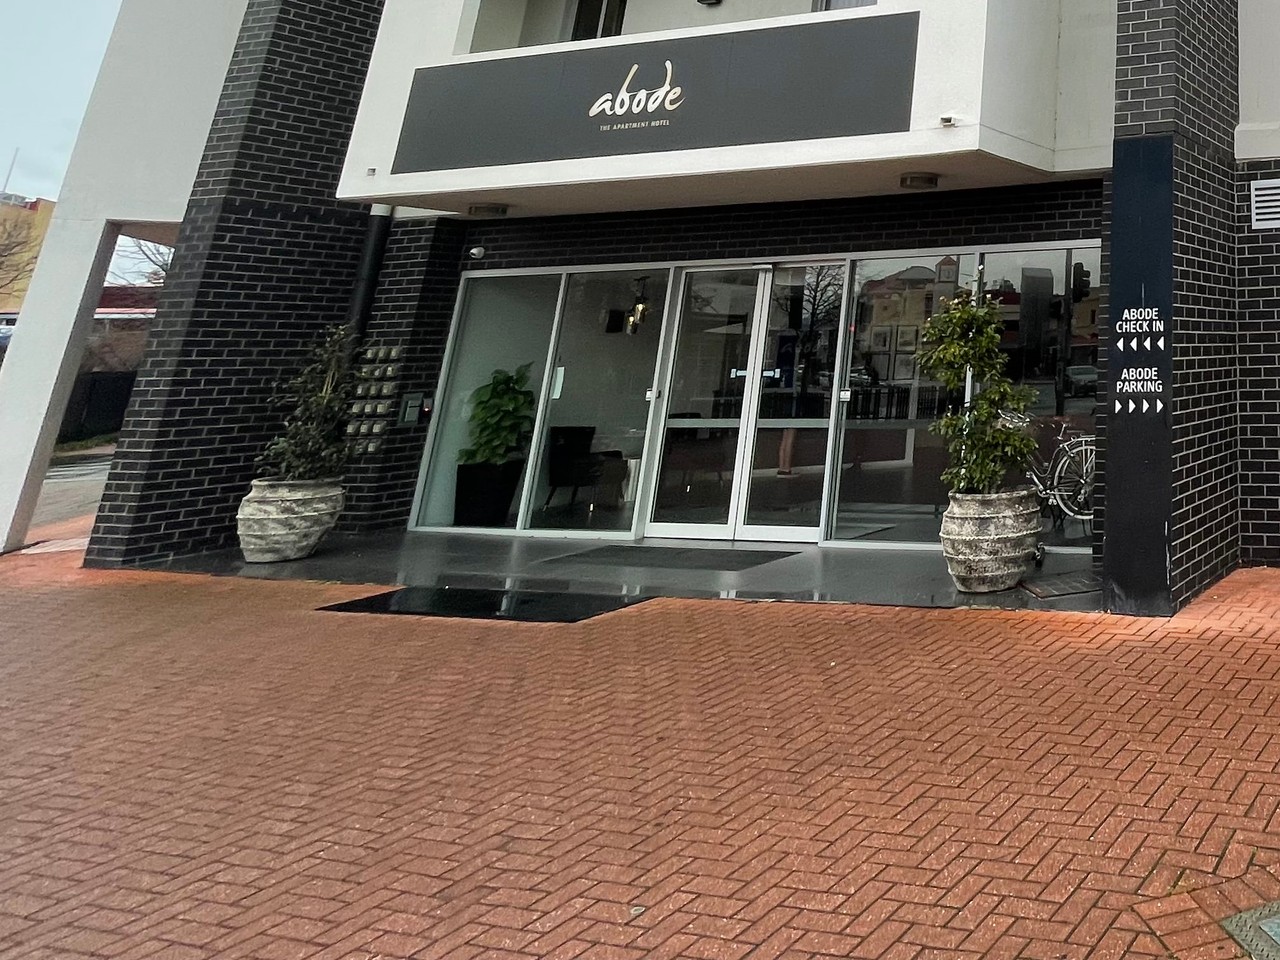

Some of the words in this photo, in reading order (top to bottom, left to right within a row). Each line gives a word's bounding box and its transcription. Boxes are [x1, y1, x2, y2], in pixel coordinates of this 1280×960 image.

[588, 59, 686, 117] abode
[599, 124, 611, 132] THE
[612, 121, 649, 130] APARTMENT
[650, 119, 670, 127] HOTEL
[1122, 308, 1158, 319] ABODE
[1115, 321, 1150, 333] CHECK
[1152, 321, 1164, 332] IN
[1121, 368, 1158, 379] ABODE
[1116, 380, 1163, 393] PARKING
